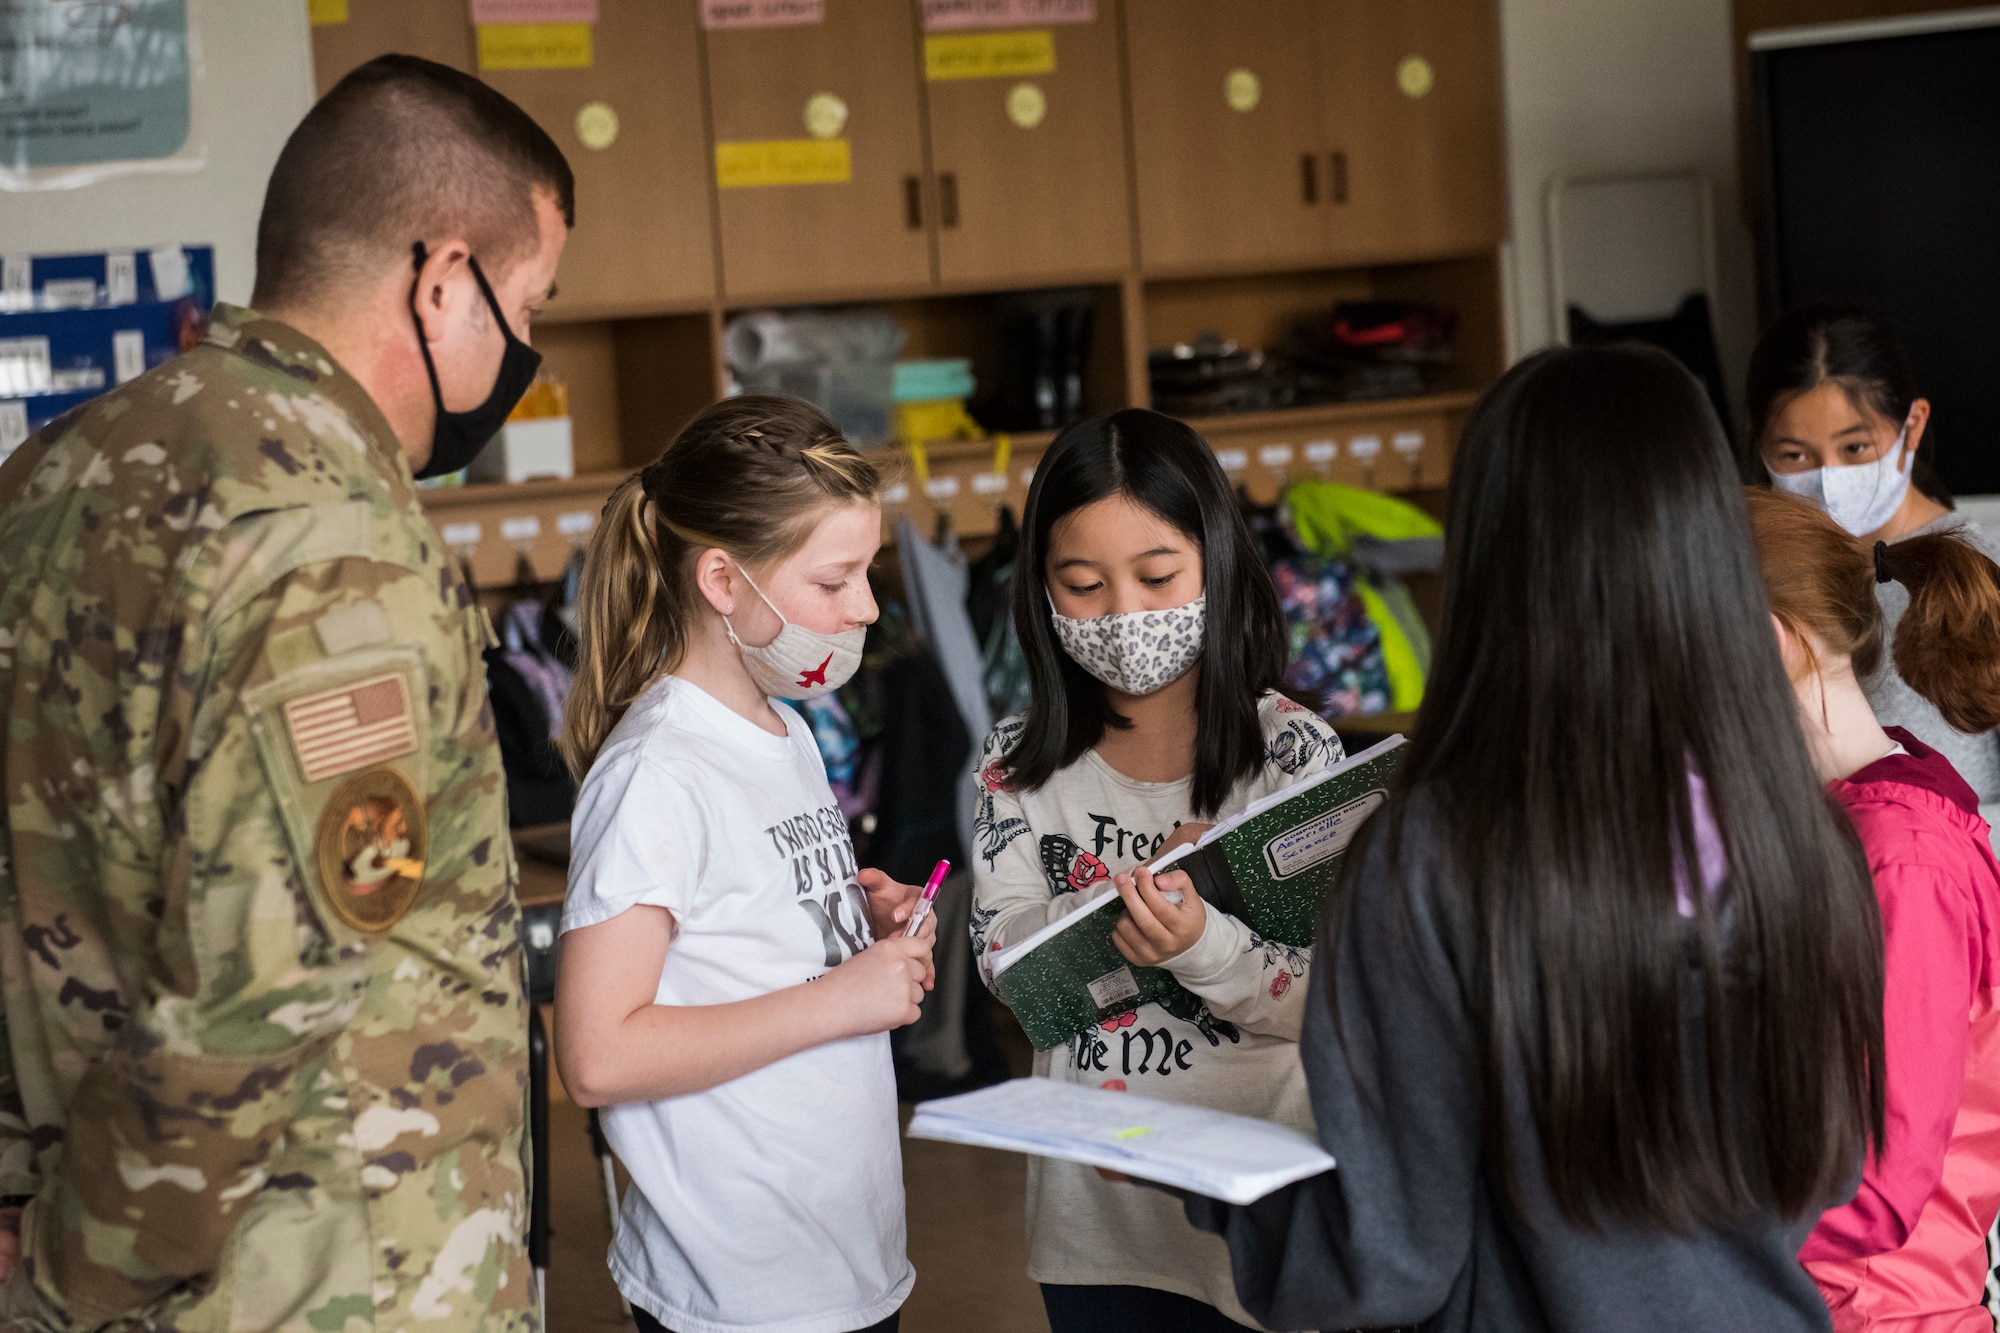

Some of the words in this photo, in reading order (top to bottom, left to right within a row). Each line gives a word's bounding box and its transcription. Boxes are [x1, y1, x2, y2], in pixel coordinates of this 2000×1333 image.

[1284, 812, 1341, 842] COMPOSITION
[1343, 801, 1367, 814] BOOK
[1282, 831, 1337, 861] Science
[792, 854, 814, 895] IS
[1077, 1030, 1109, 1072] be
[1121, 1027, 1194, 1076] Me
